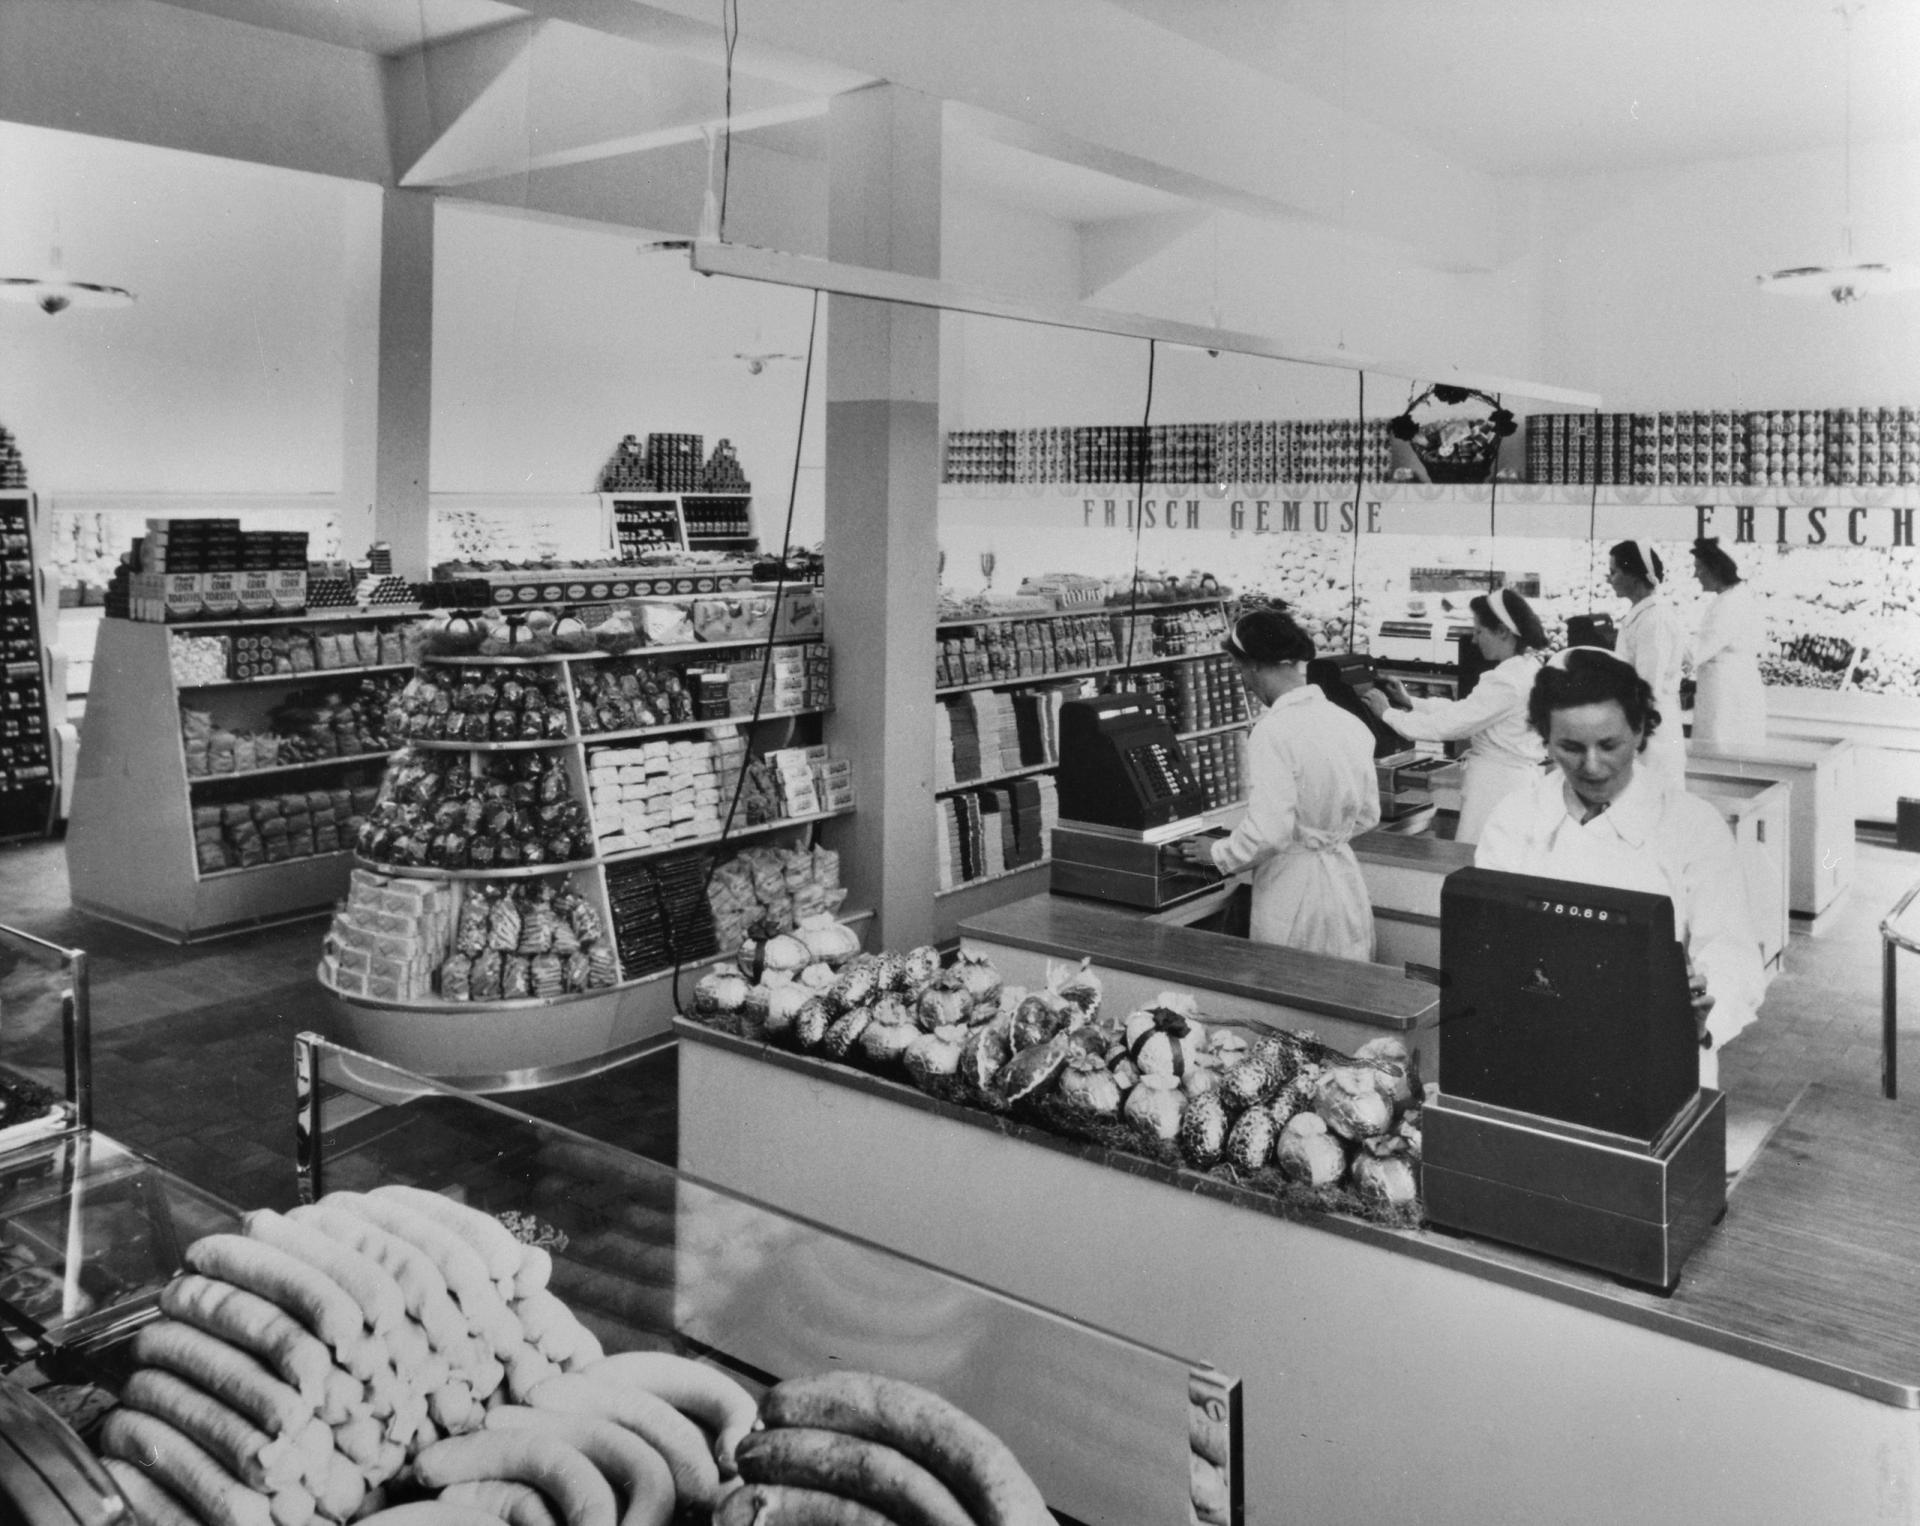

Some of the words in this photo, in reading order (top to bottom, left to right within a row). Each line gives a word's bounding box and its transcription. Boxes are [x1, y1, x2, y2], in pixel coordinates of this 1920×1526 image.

[1083, 499, 1200, 529] FRISCH
[1230, 500, 1382, 533] GEMUSE
[1695, 505, 1916, 546] FRISCH
